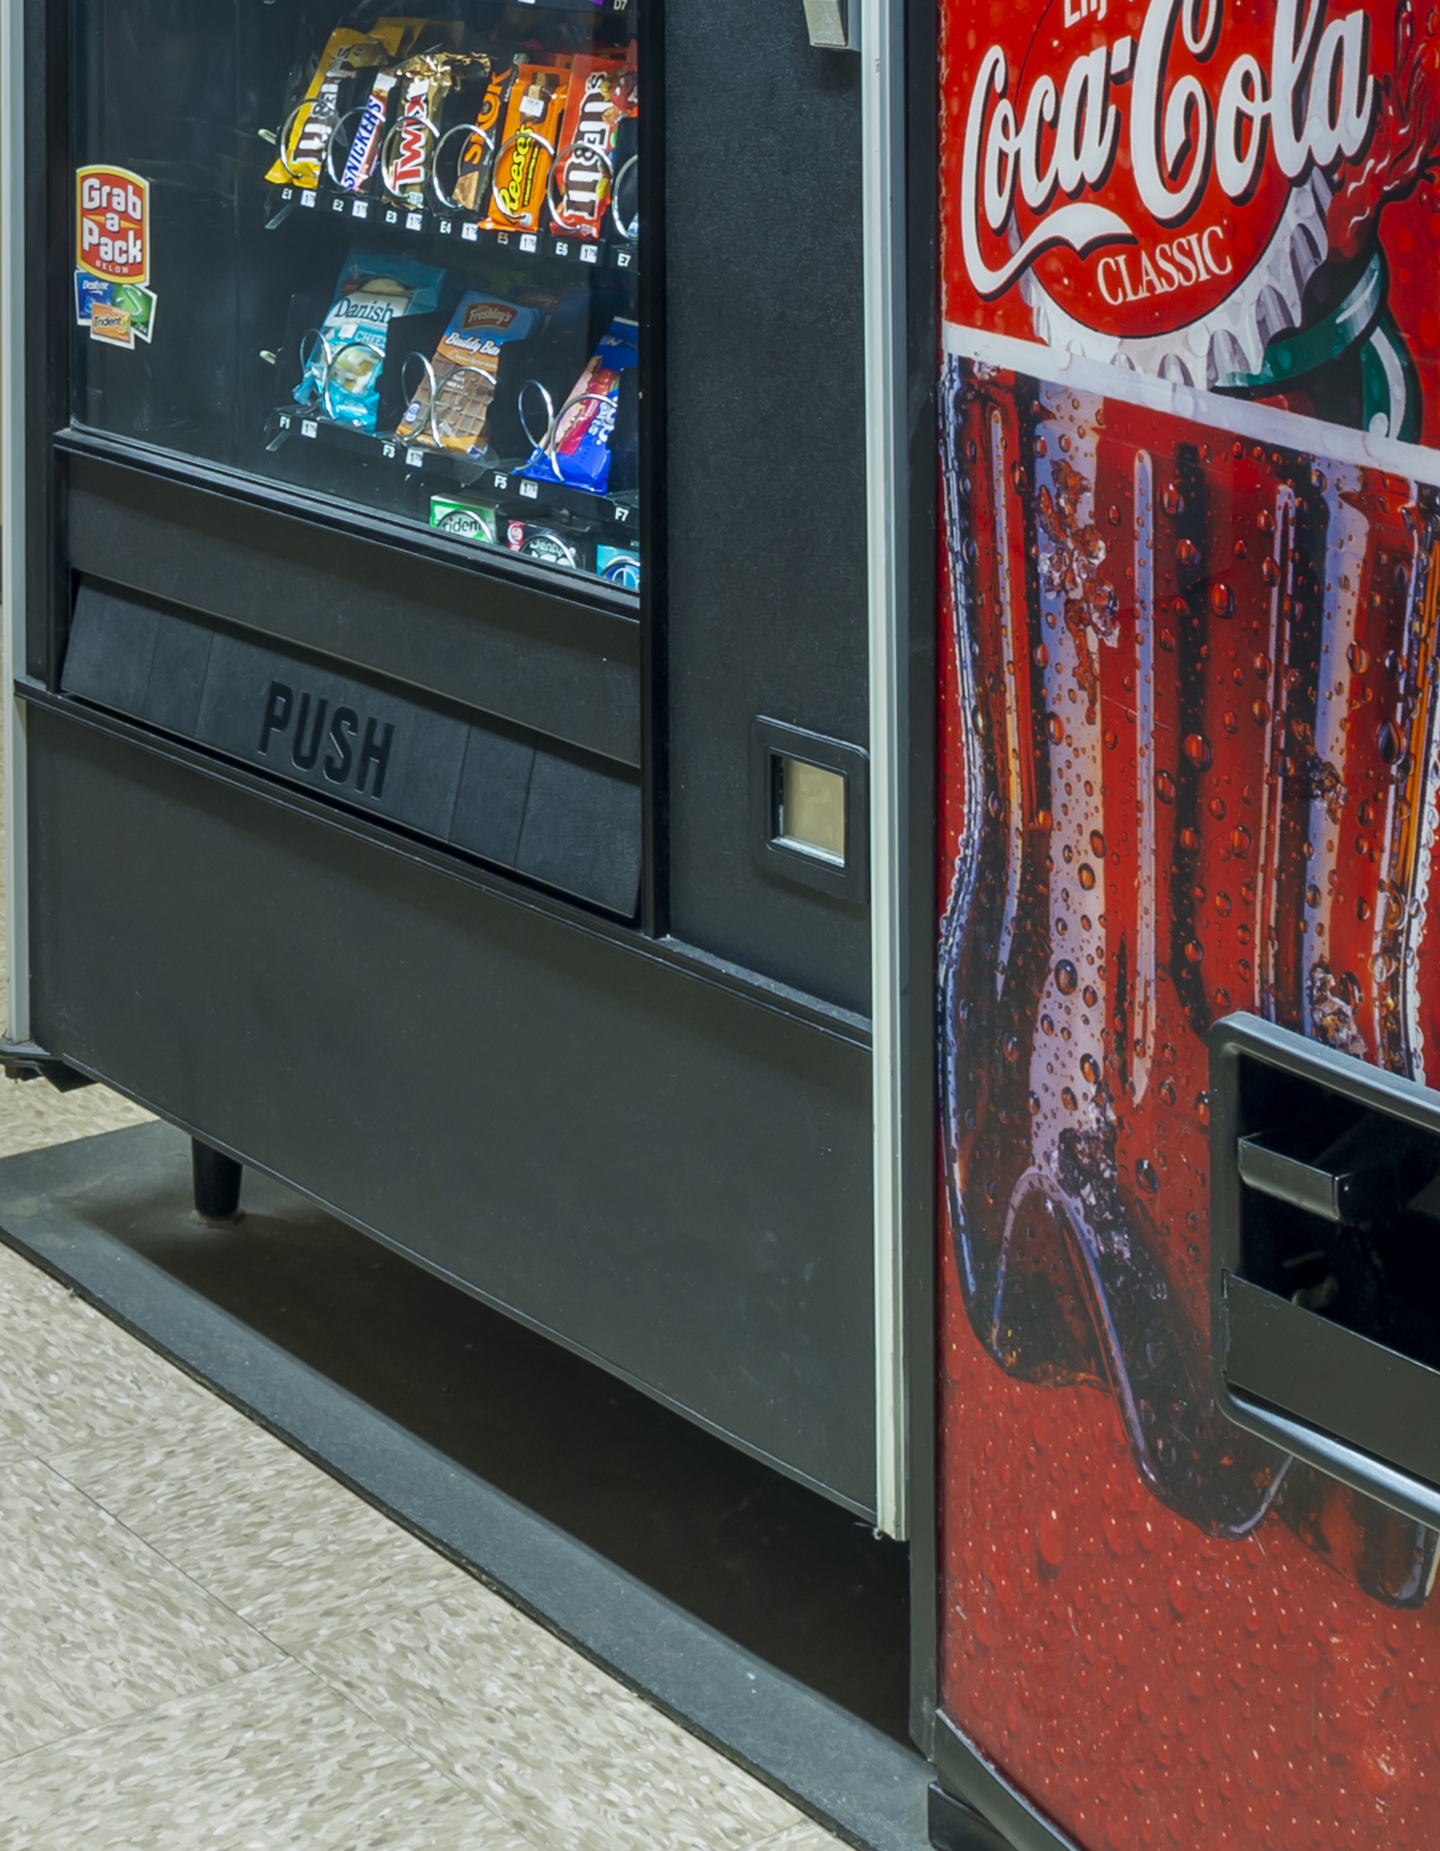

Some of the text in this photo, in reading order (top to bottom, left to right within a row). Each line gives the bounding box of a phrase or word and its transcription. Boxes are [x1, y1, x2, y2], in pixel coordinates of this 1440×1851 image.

[613, 0, 627, 10] D7
[342, 94, 383, 190] SNICKERS
[498, 123, 535, 215] Reese's
[82, 178, 142, 220] Grab
[282, 188, 292, 199] E1
[333, 199, 344, 211] E2
[105, 212, 120, 233] a
[440, 221, 451, 233] E4
[82, 217, 142, 264] Pack
[498, 233, 508, 244] E5
[556, 242, 568, 255] E6
[96, 259, 129, 274] BELOW
[618, 253, 631, 267] E7
[1096, 225, 1233, 306] CLASSIC
[334, 298, 394, 323] Danish
[468, 307, 512, 326] Freshley's
[93, 314, 122, 327] Trident
[445, 332, 501, 356] Buddy Bar
[279, 415, 291, 429] F1
[383, 445, 395, 458] F3
[494, 475, 507, 488] F5
[615, 508, 629, 521] F7
[258, 680, 396, 802] PUSH
